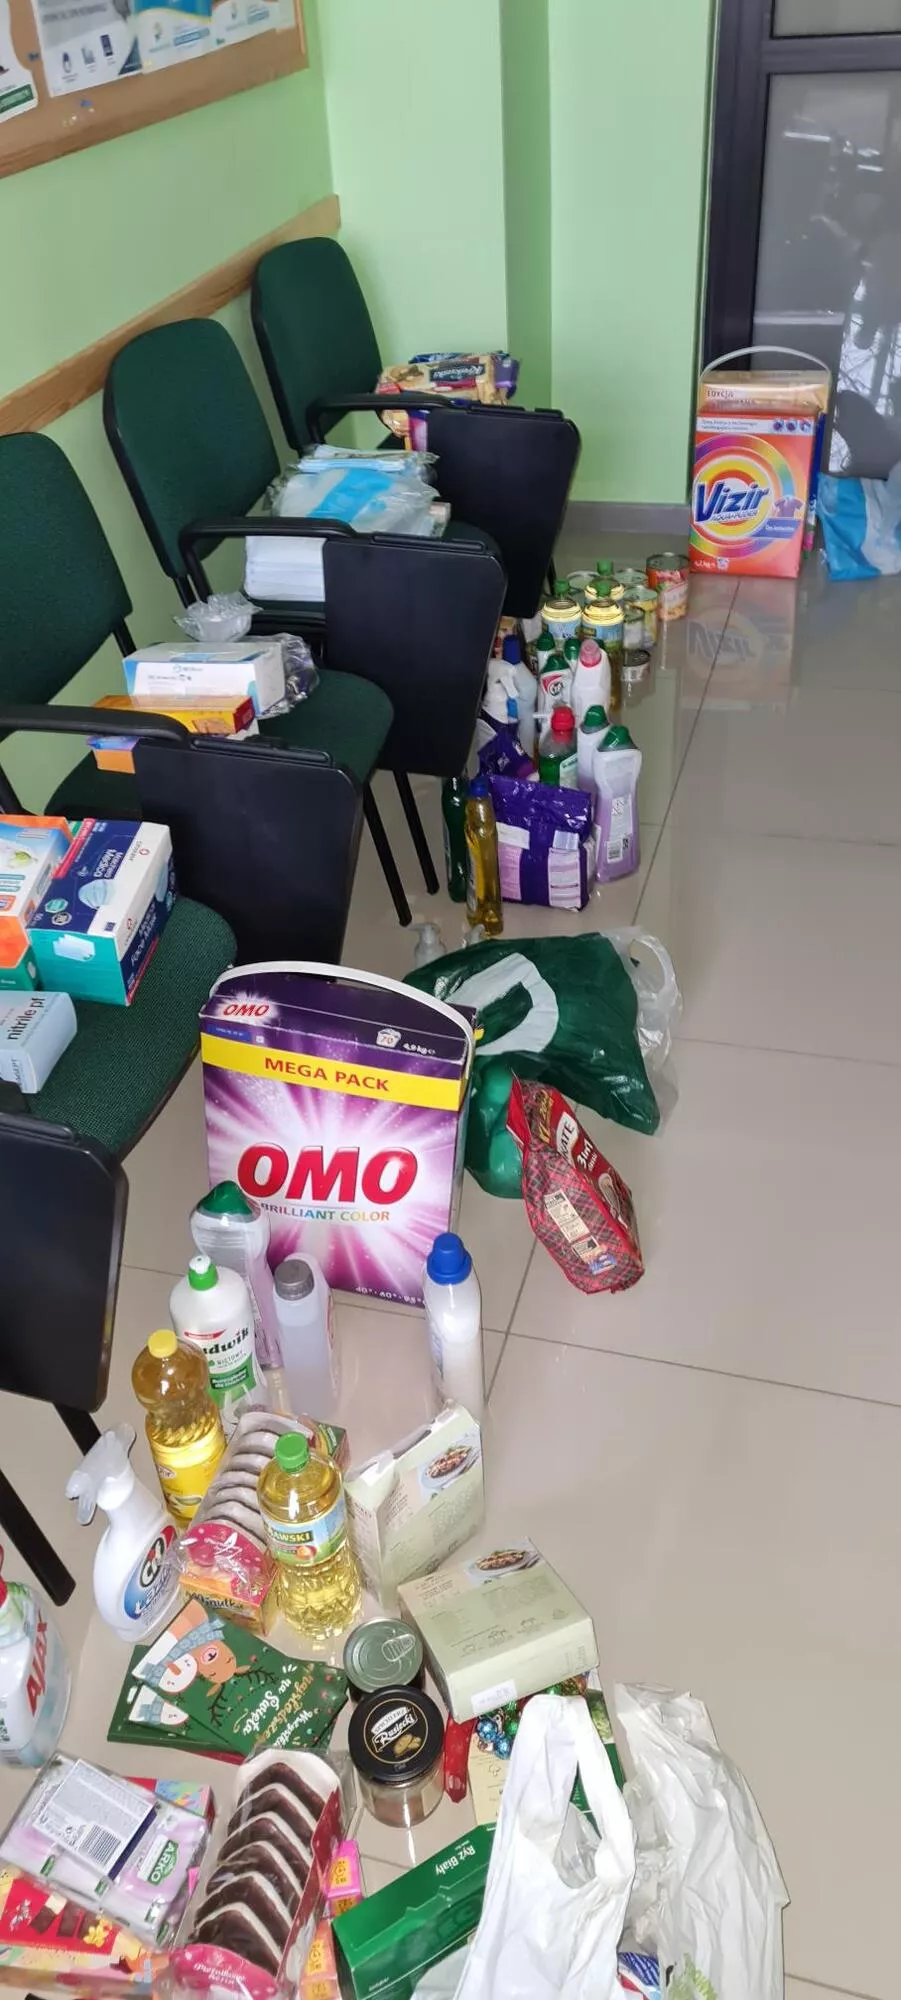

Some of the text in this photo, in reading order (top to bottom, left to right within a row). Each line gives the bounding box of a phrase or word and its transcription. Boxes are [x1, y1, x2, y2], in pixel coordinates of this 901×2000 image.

[695, 482, 769, 522] Vizir
[7, 1008, 37, 1040] nitrile
[222, 1003, 270, 1018] OMO
[264, 1056, 390, 1092] MEGA PACK
[237, 1142, 419, 1206] OMO
[260, 1202, 390, 1222] BRILLIANT COLOR
[26, 1611, 48, 1717] AJAX
[242, 1678, 292, 1737] na Święta
[272, 1709, 313, 1748] Wszystki
[151, 1841, 175, 1882] ARKO
[435, 1856, 459, 1876] Biały
[457, 1845, 476, 1861] Ryż
